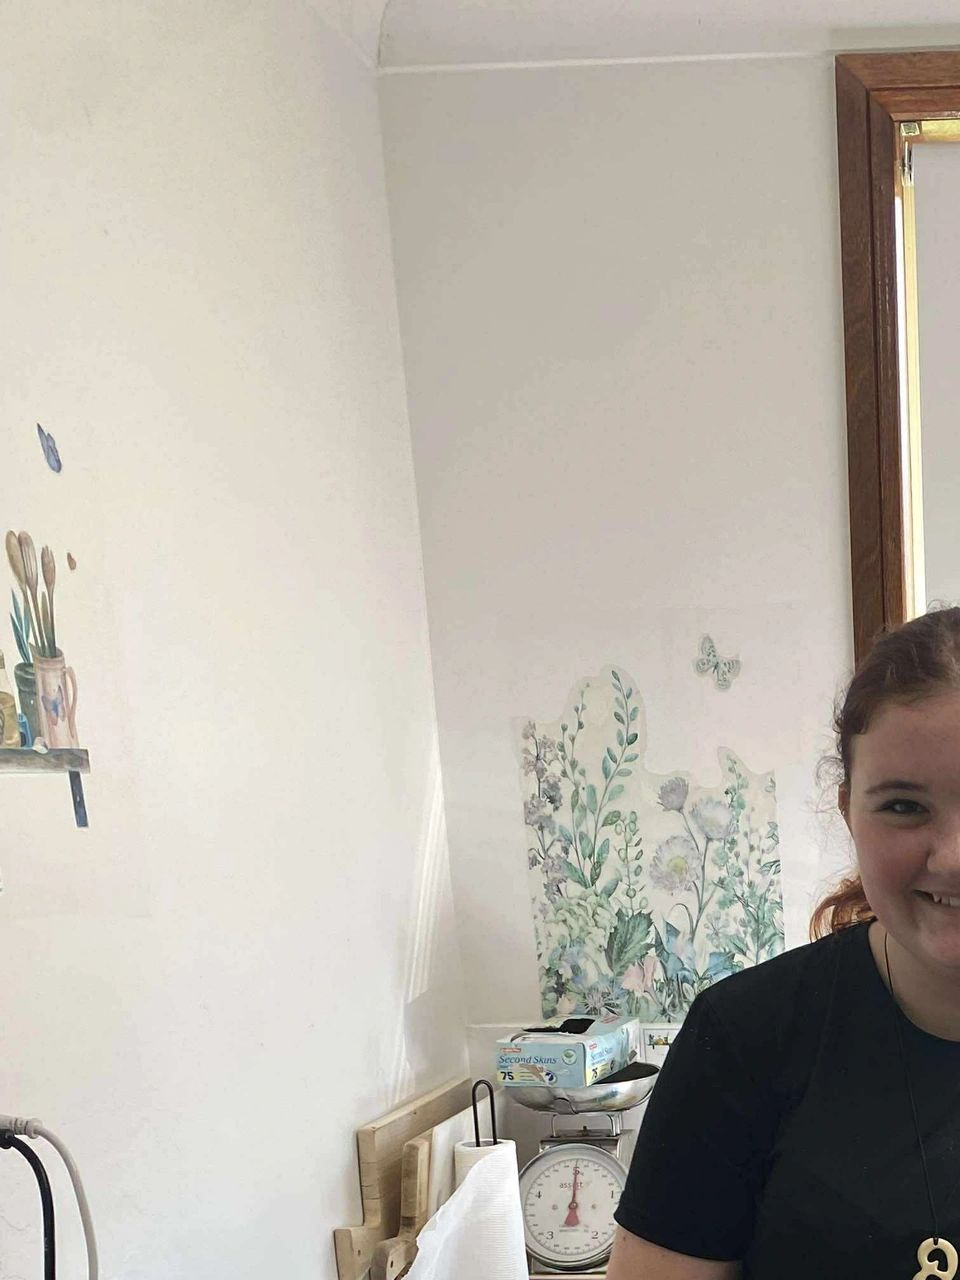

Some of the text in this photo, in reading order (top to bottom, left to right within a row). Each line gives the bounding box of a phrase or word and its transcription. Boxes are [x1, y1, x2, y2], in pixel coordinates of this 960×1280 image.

[498, 1055, 558, 1064] Second Skins
[500, 1071, 515, 1081] 75
[535, 1190, 542, 1199] 4
[545, 1231, 554, 1240] 3
[591, 1230, 599, 1240] 2
